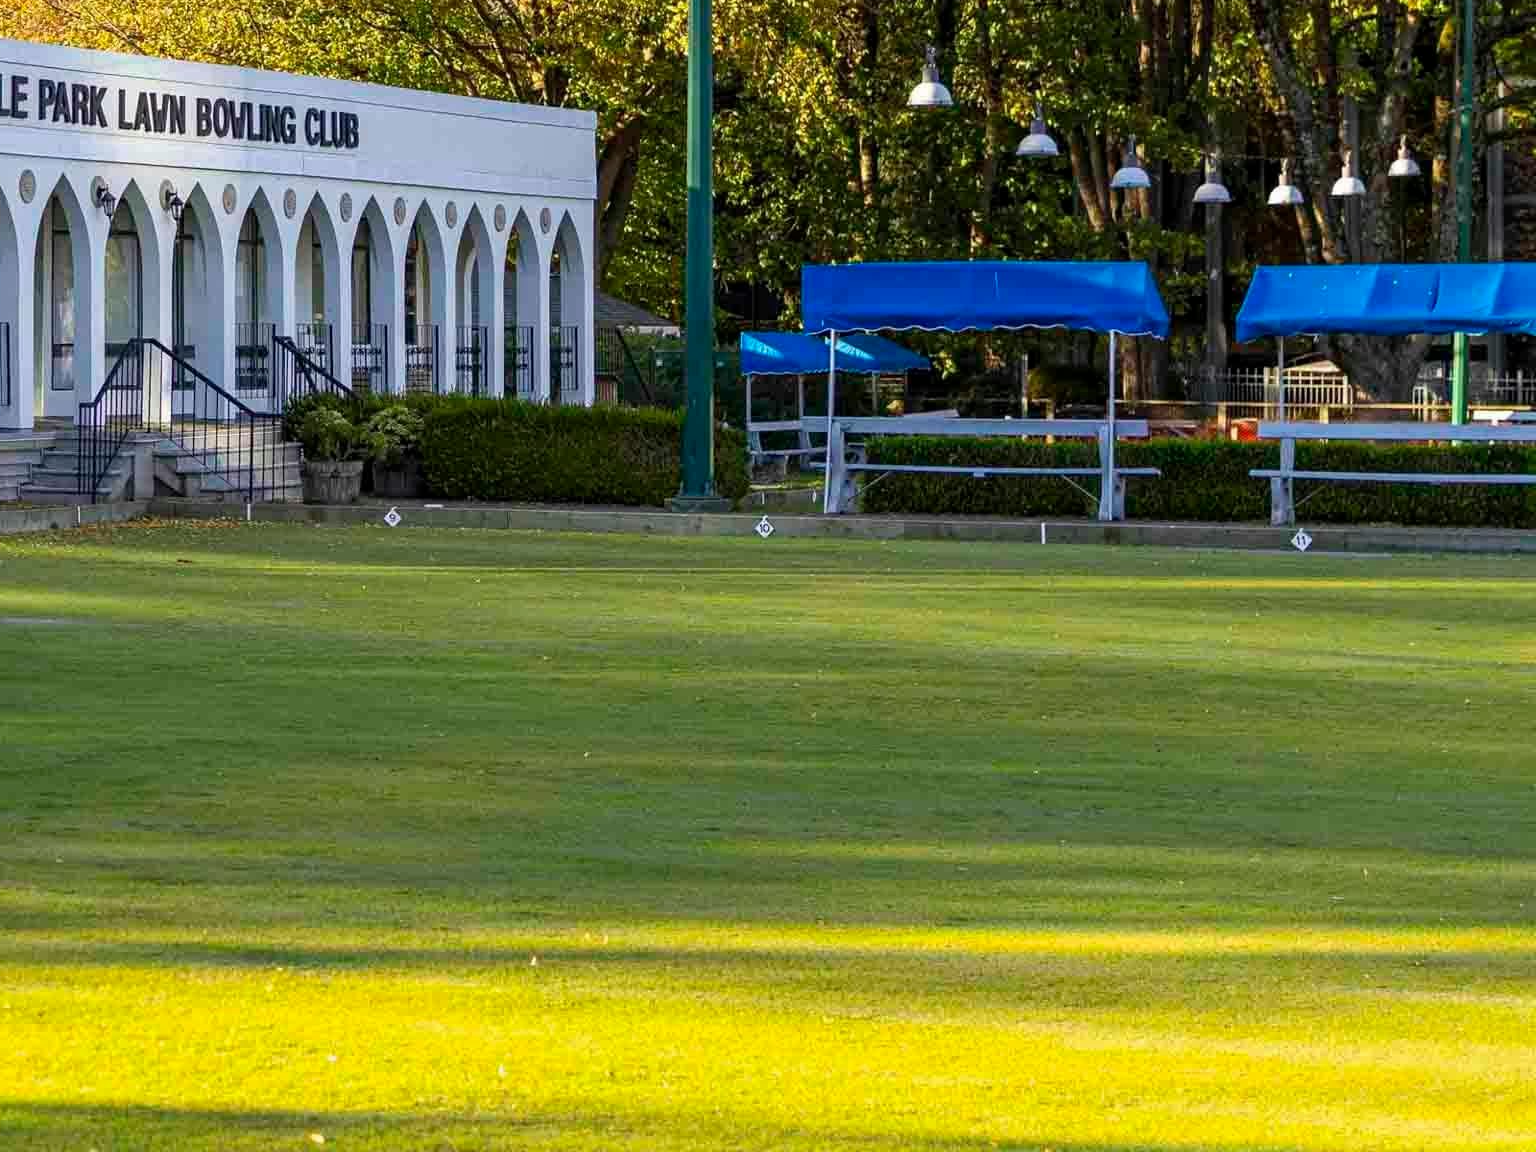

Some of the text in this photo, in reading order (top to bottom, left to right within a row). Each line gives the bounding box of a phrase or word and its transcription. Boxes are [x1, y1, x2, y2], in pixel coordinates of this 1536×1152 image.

[38, 78, 108, 128] PARK
[118, 87, 187, 135] LAWN
[195, 97, 297, 145] BOWLING
[304, 107, 360, 149] CLUB
[759, 523, 770, 534] 10
[1296, 535, 1306, 545] 11
